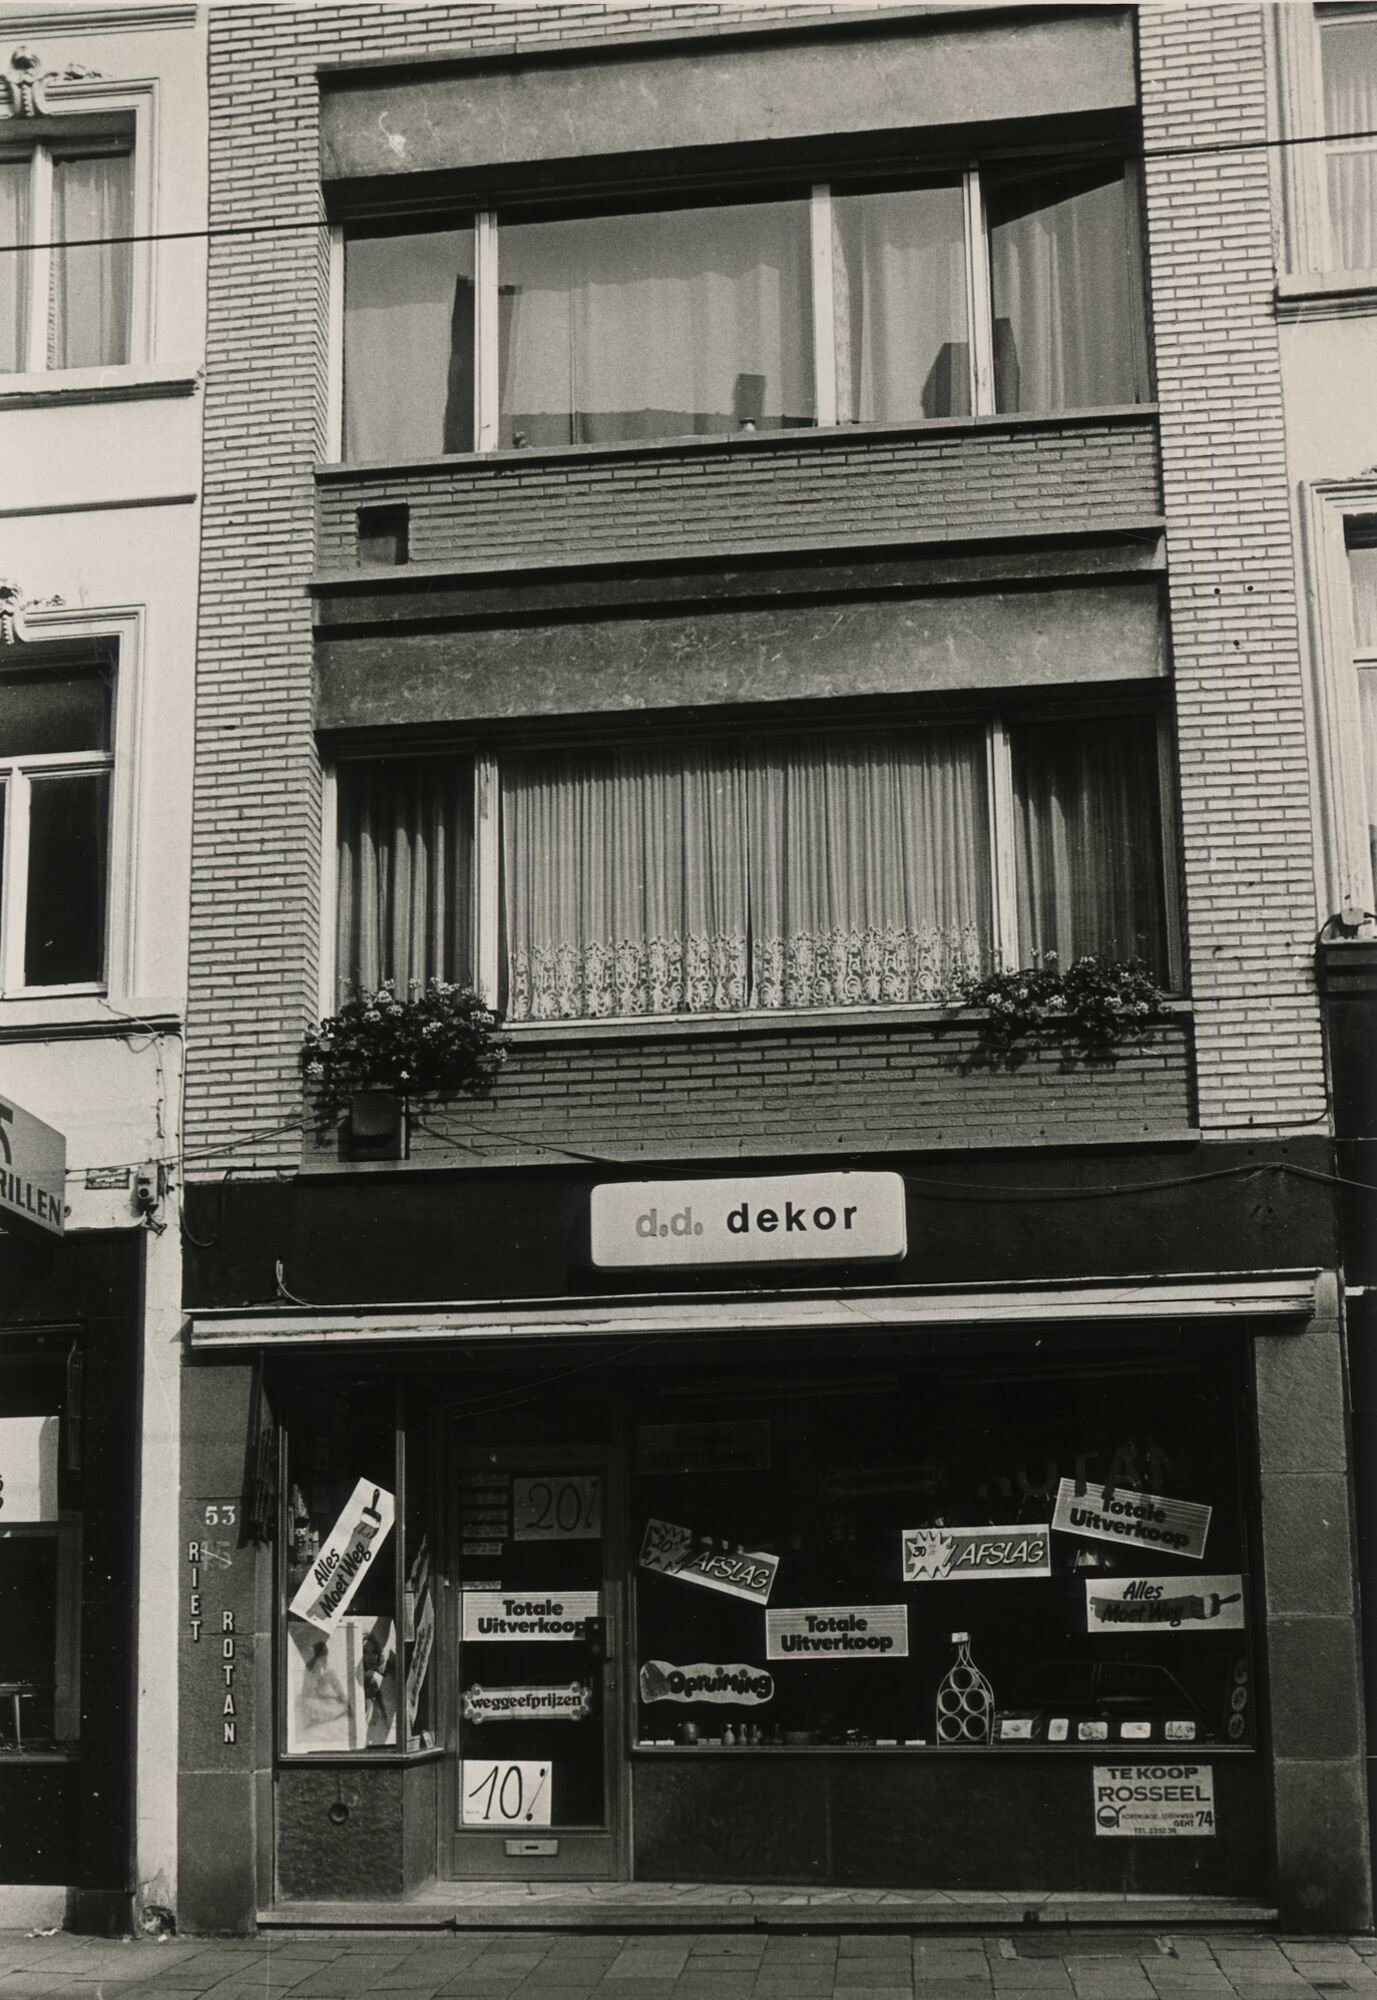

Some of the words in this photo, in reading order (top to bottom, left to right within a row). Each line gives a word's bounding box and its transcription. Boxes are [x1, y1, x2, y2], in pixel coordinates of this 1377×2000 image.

[635, 1206, 703, 1238] d.d.
[726, 1201, 858, 1234] dekor
[205, 1506, 236, 1526] 53
[1102, 1494, 1166, 1523] Totale
[1069, 1508, 1190, 1549] Uitverkoop
[955, 1540, 1044, 1566] AFSLAG
[314, 1548, 340, 1588] Alles
[319, 1573, 349, 1618] Moet
[339, 1541, 372, 1577] Weg
[687, 1551, 771, 1589] AFSLAG
[188, 1542, 202, 1641] RIET
[1123, 1581, 1164, 1600] Alles
[503, 1599, 564, 1616] Totale
[1101, 1603, 1147, 1623] Moet
[1149, 1601, 1185, 1627] Weg
[805, 1615, 867, 1633] Totale
[781, 1633, 893, 1653] Uitverkoop
[222, 1611, 235, 1743] ROTAN
[470, 1693, 583, 1710] weggeefprijzen
[1107, 1768, 1132, 1780] TE
[1137, 1767, 1198, 1780] KOOP
[468, 1765, 550, 1822] 10%
[1098, 1786, 1210, 1802] ROSSEEL
[1196, 1811, 1213, 1827] 74
